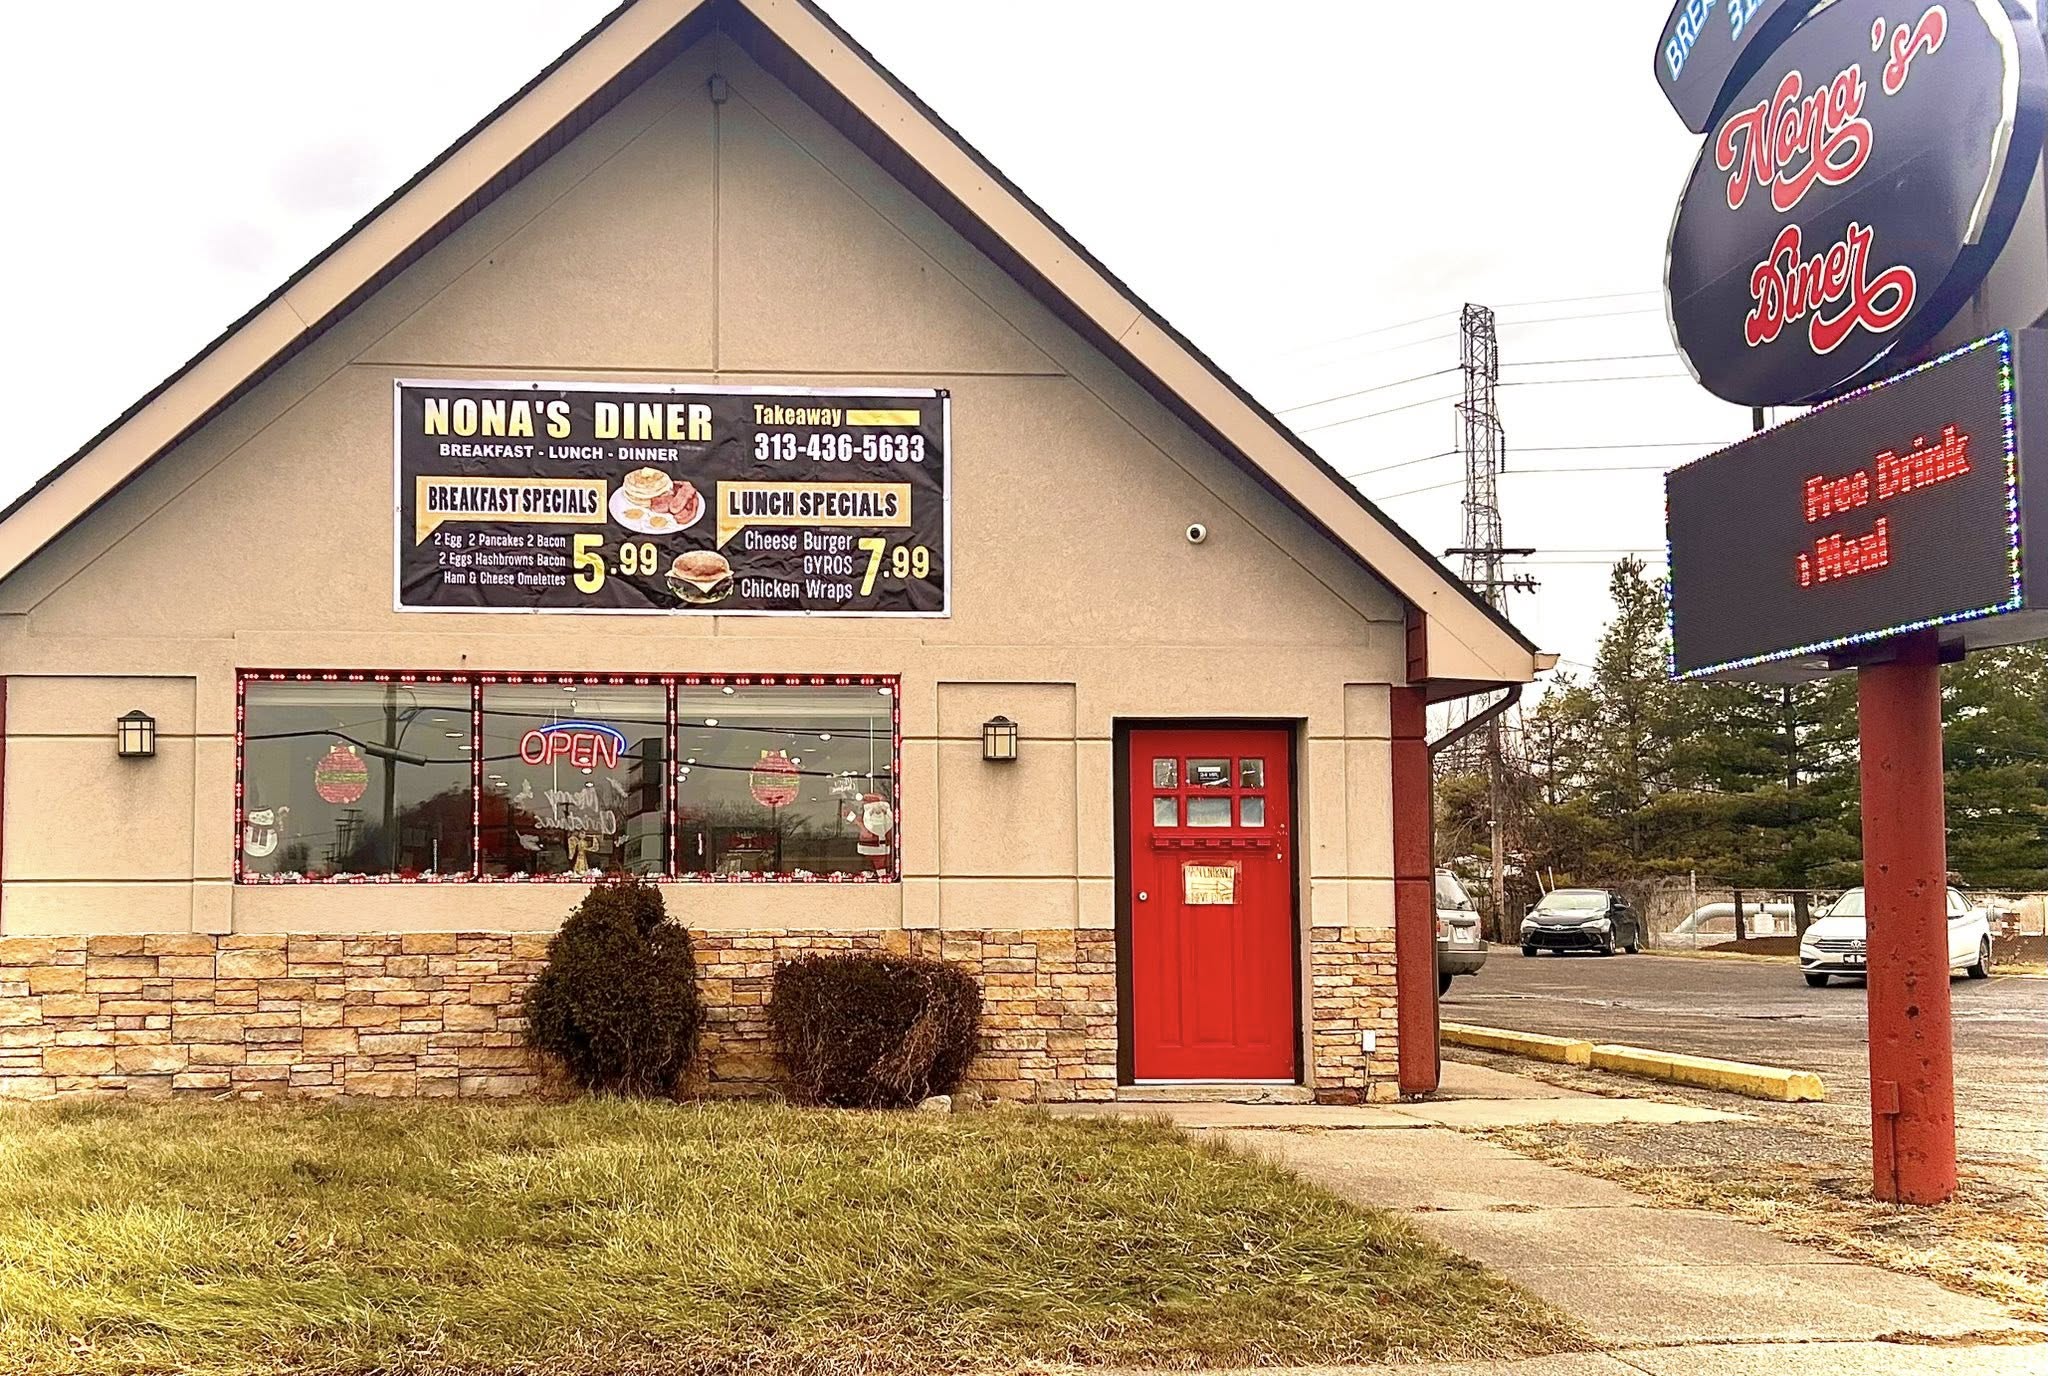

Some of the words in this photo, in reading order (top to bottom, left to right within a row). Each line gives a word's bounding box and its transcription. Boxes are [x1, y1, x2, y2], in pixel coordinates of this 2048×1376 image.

[1744, 221, 1917, 355] Diner
[423, 398, 571, 439] NONA'S
[594, 401, 713, 441] DINER
[753, 404, 842, 427] Takeaway
[439, 443, 534, 459] BREAKFAST
[549, 446, 603, 460] LUNCH
[618, 447, 679, 461] DINNER
[754, 432, 925, 463] 313-436-5633
[1804, 469, 1869, 523] Free
[1875, 424, 1971, 501] Drink
[428, 486, 519, 513] BREAKFAST
[522, 488, 598, 514] SPECIALS
[729, 491, 795, 516] LUNCH
[799, 492, 898, 517] SPECIALS
[434, 534, 442, 546] 2
[443, 534, 463, 548] Egg
[468, 534, 476, 547] 2
[478, 534, 524, 547] Pancakes
[527, 535, 535, 547] 2
[537, 535, 567, 548] Bacon
[744, 530, 797, 551] Cheese
[803, 531, 853, 554] Burger
[1797, 553, 1811, 587] 1
[1815, 516, 1889, 583] Meal
[439, 553, 447, 565] 2
[449, 553, 473, 567] Eggs
[475, 553, 534, 566] Hashbrowns
[537, 554, 567, 567] Bacon
[573, 533, 658, 594] 5.99
[803, 555, 853, 575] GYROS
[858, 537, 930, 597] 7.99
[444, 572, 466, 585] Ham
[469, 572, 478, 584] &
[480, 572, 515, 585] Cheese
[518, 572, 567, 586] Omelettes
[741, 578, 800, 599] Chicken
[806, 579, 854, 602] Wraps
[520, 729, 620, 769] OPEN
